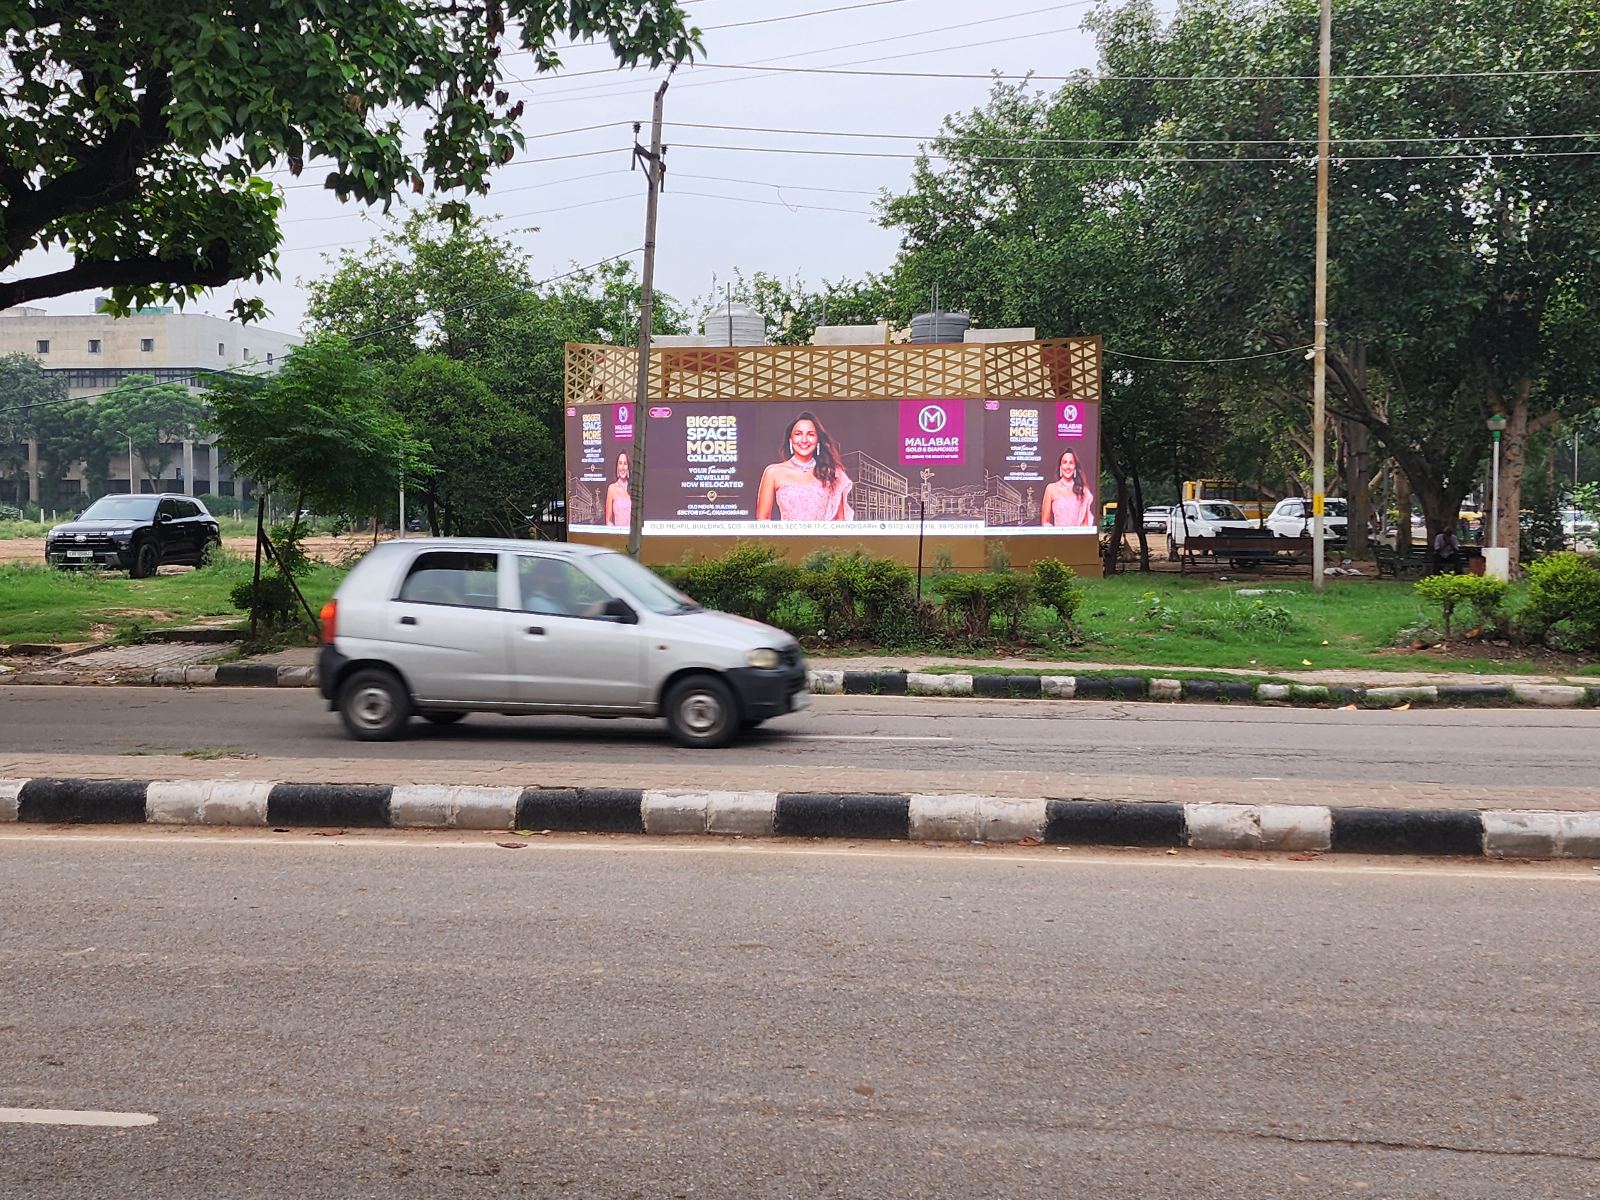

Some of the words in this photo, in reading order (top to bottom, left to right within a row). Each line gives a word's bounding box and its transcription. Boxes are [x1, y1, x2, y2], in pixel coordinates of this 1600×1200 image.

[1010, 409, 1038, 418] BIGGER
[583, 422, 602, 430] SPACE
[686, 416, 736, 428] BIGGER
[1010, 418, 1038, 426] SPACE
[583, 430, 602, 440] MORE
[686, 428, 737, 440] SPACE
[1010, 426, 1038, 436] MORE
[686, 440, 738, 454] MORE
[904, 438, 959, 446] MALABAR
